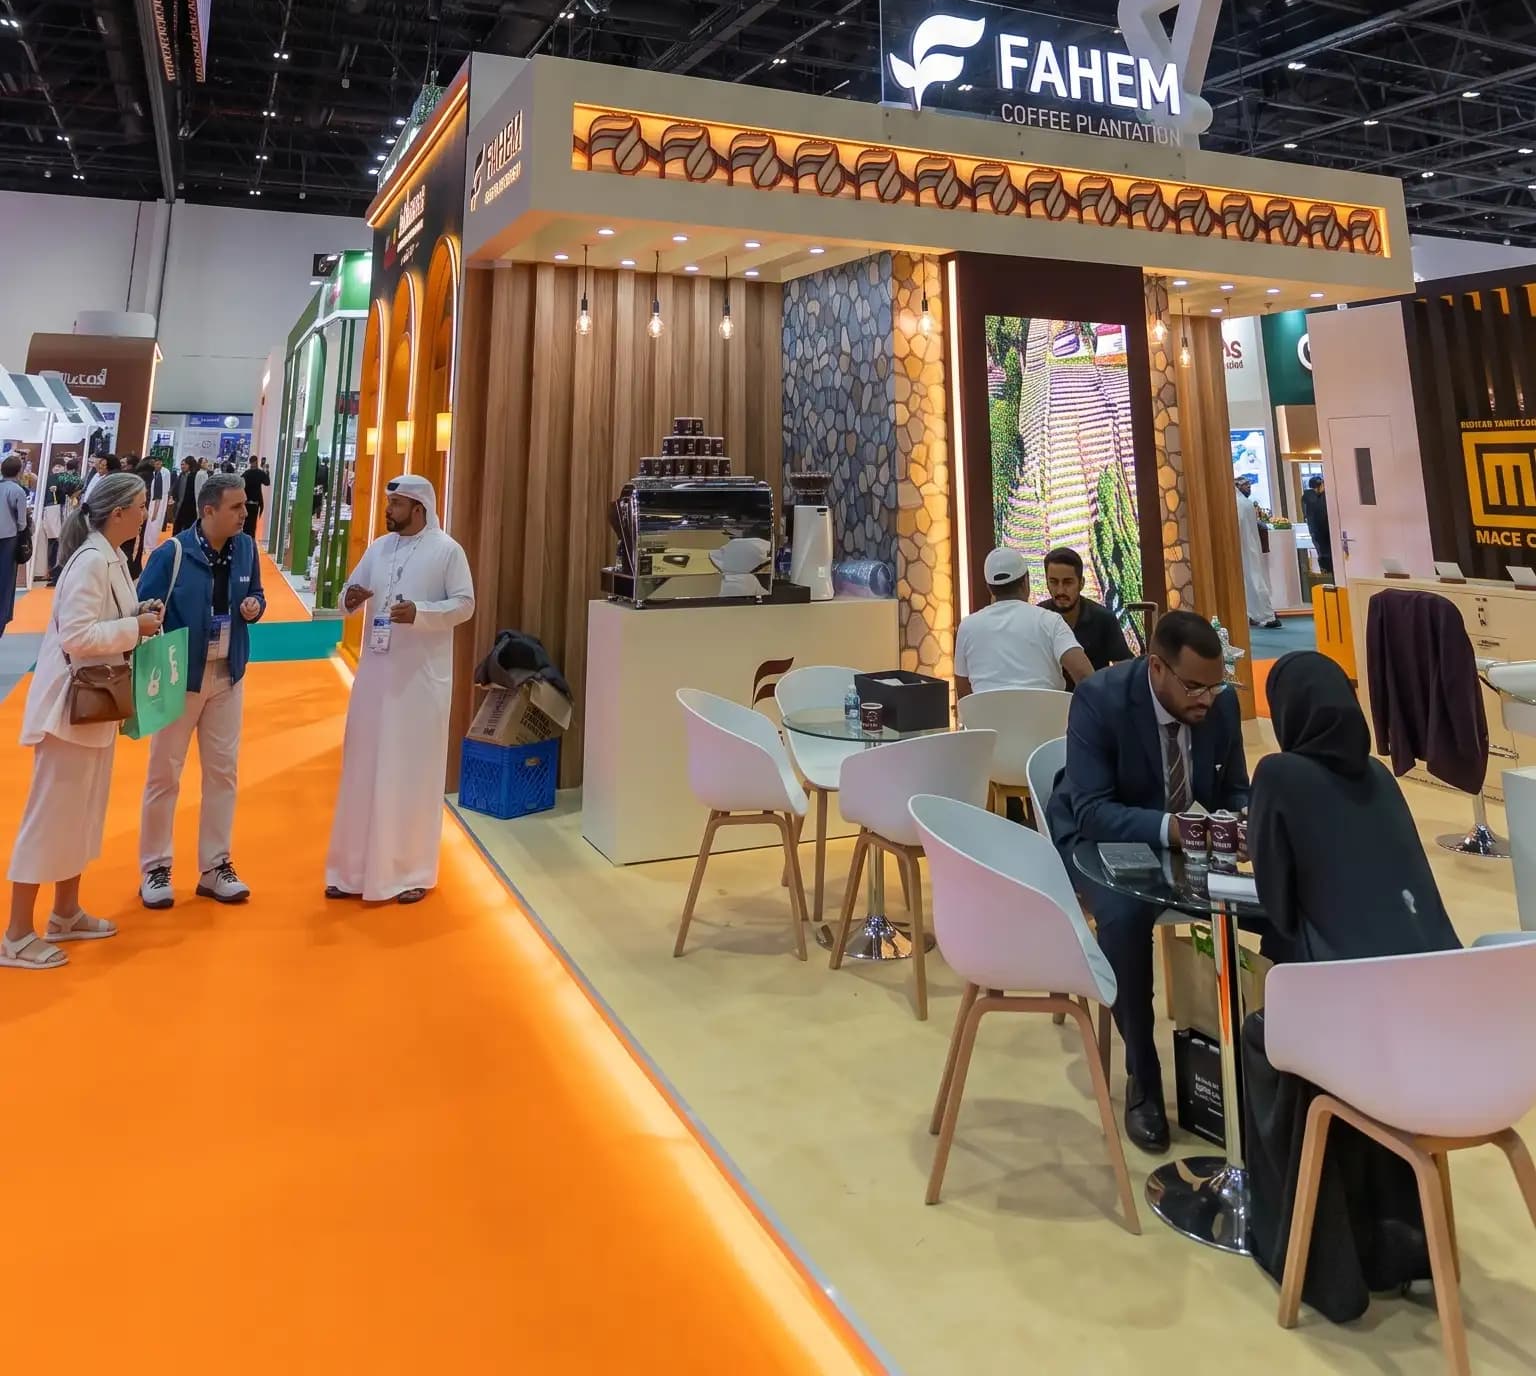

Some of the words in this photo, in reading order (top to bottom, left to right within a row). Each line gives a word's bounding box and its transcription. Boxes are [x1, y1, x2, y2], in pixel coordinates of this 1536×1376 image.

[998, 33, 1181, 115] FAHEM
[1001, 103, 1071, 131] COFFEE
[1076, 114, 1182, 147] PLANTATION
[1476, 530, 1522, 547] MACE
